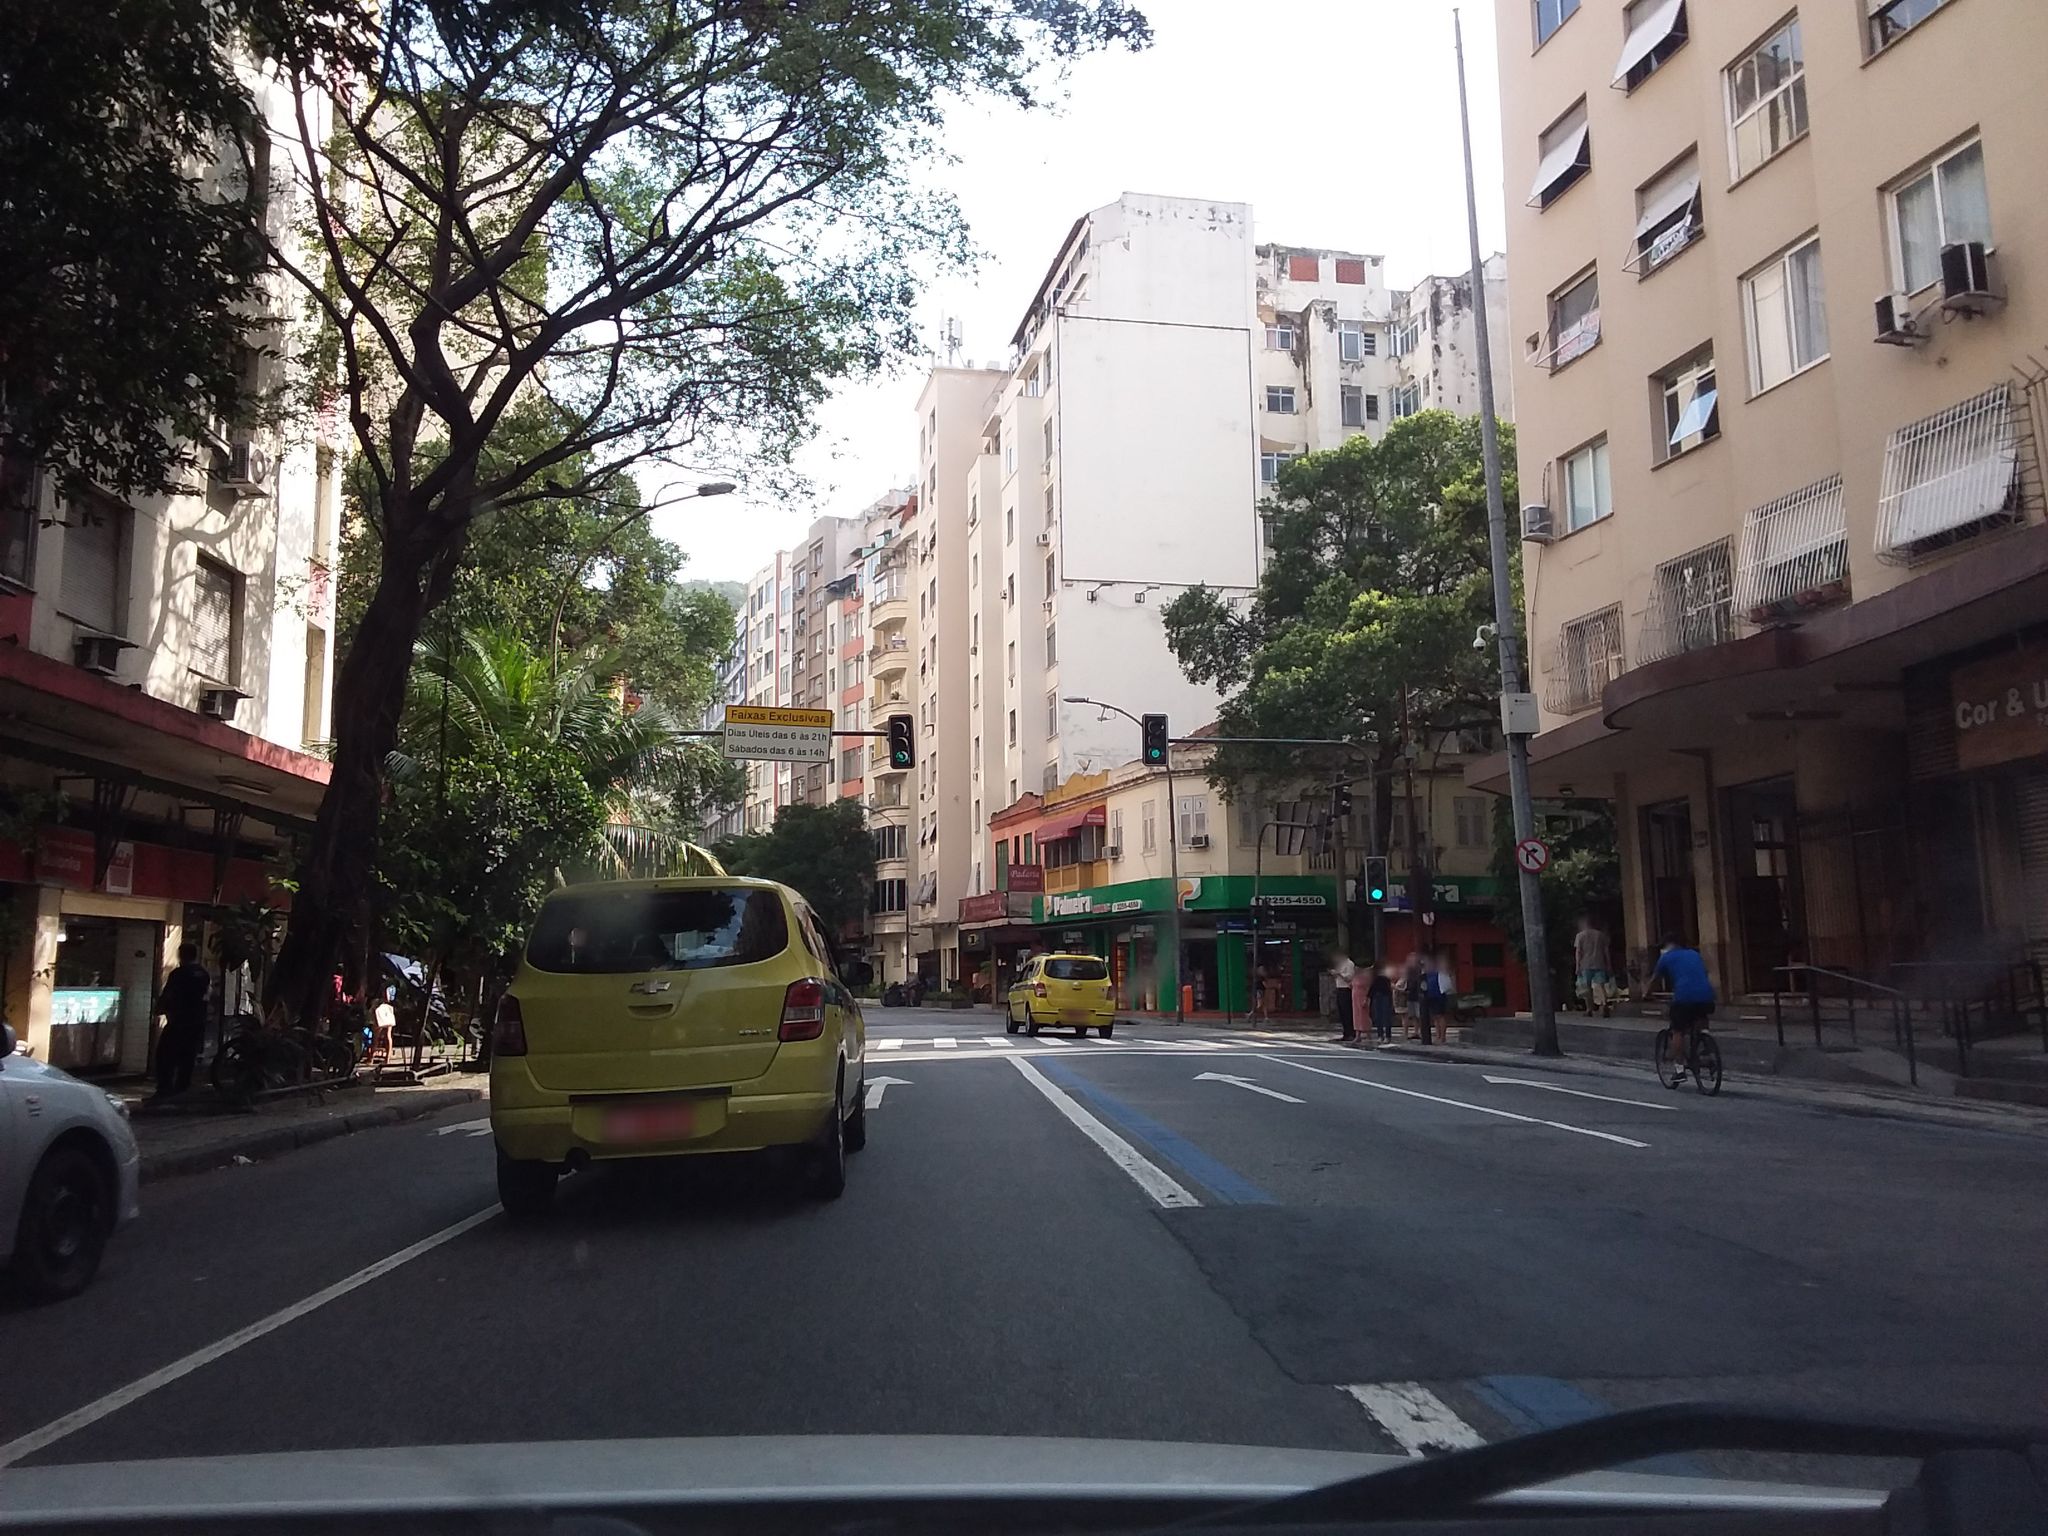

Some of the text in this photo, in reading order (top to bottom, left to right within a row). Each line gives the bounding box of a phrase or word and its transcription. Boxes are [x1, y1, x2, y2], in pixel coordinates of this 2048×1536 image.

[1956, 700, 1998, 729] Cor
[2006, 687, 2025, 717] &
[731, 709, 826, 723] Faixas Exclusivas
[727, 728, 746, 737] Dias
[772, 730, 788, 740] das
[790, 731, 797, 740] 6
[811, 733, 827, 741] 21h
[769, 746, 787, 755] das
[788, 747, 794, 755] 6
[810, 748, 825, 757] 14h
